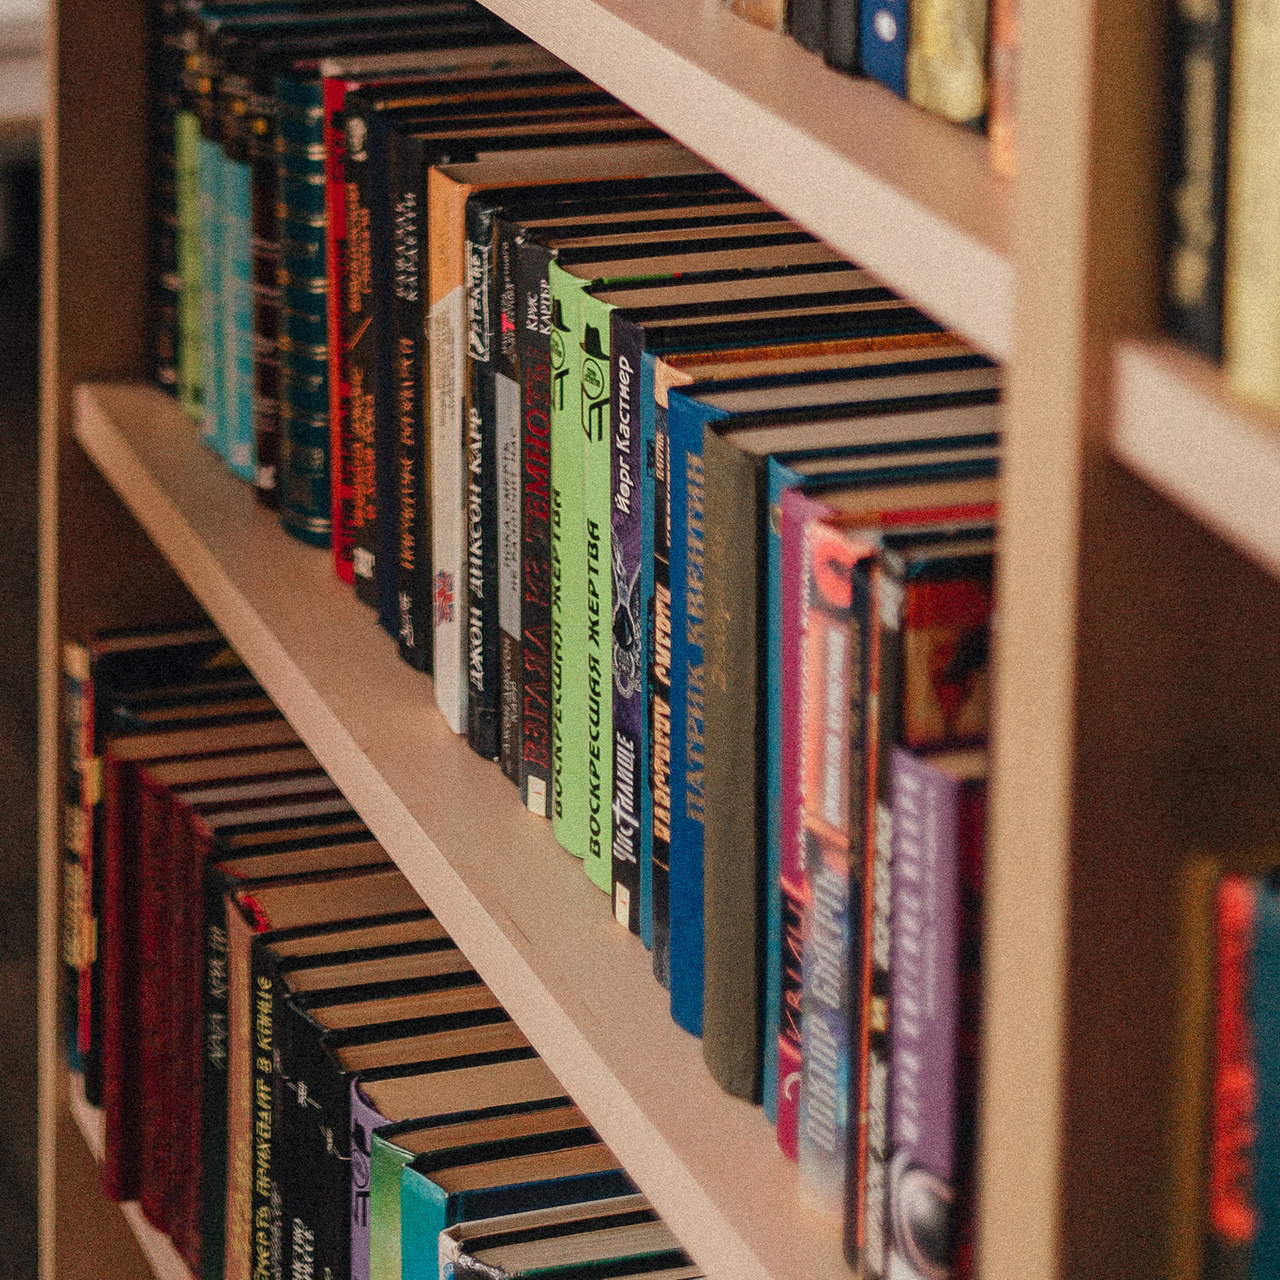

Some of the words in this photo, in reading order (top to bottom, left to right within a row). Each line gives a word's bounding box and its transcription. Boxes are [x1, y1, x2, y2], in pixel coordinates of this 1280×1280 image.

[526, 291, 539, 332] КРИС
[539, 278, 551, 335] КАРТЕР
[469, 408, 482, 474] КАРР
[525, 345, 551, 543] ТЕМНОТЫ
[617, 355, 633, 454] Кастнер
[656, 431, 665, 481] ПАТРИК
[615, 456, 635, 514] Йорг
[469, 484, 484, 598] ДИКСОН
[525, 556, 550, 606] ИЗ
[587, 518, 600, 649] ЖЕРТВА
[686, 450, 705, 649] КВЕНТИН
[469, 606, 484, 691] ДЖОН
[655, 581, 672, 687] СМЕРТИ
[523, 624, 550, 769] ВЗГЛЯД
[686, 659, 706, 825] ПАТРИК
[588, 653, 602, 859] ВОСКРЕСШАЯ
[613, 731, 640, 863] ЧИСТИЛИЩЕ
[653, 694, 671, 843] НАВСТРЕЧУ
